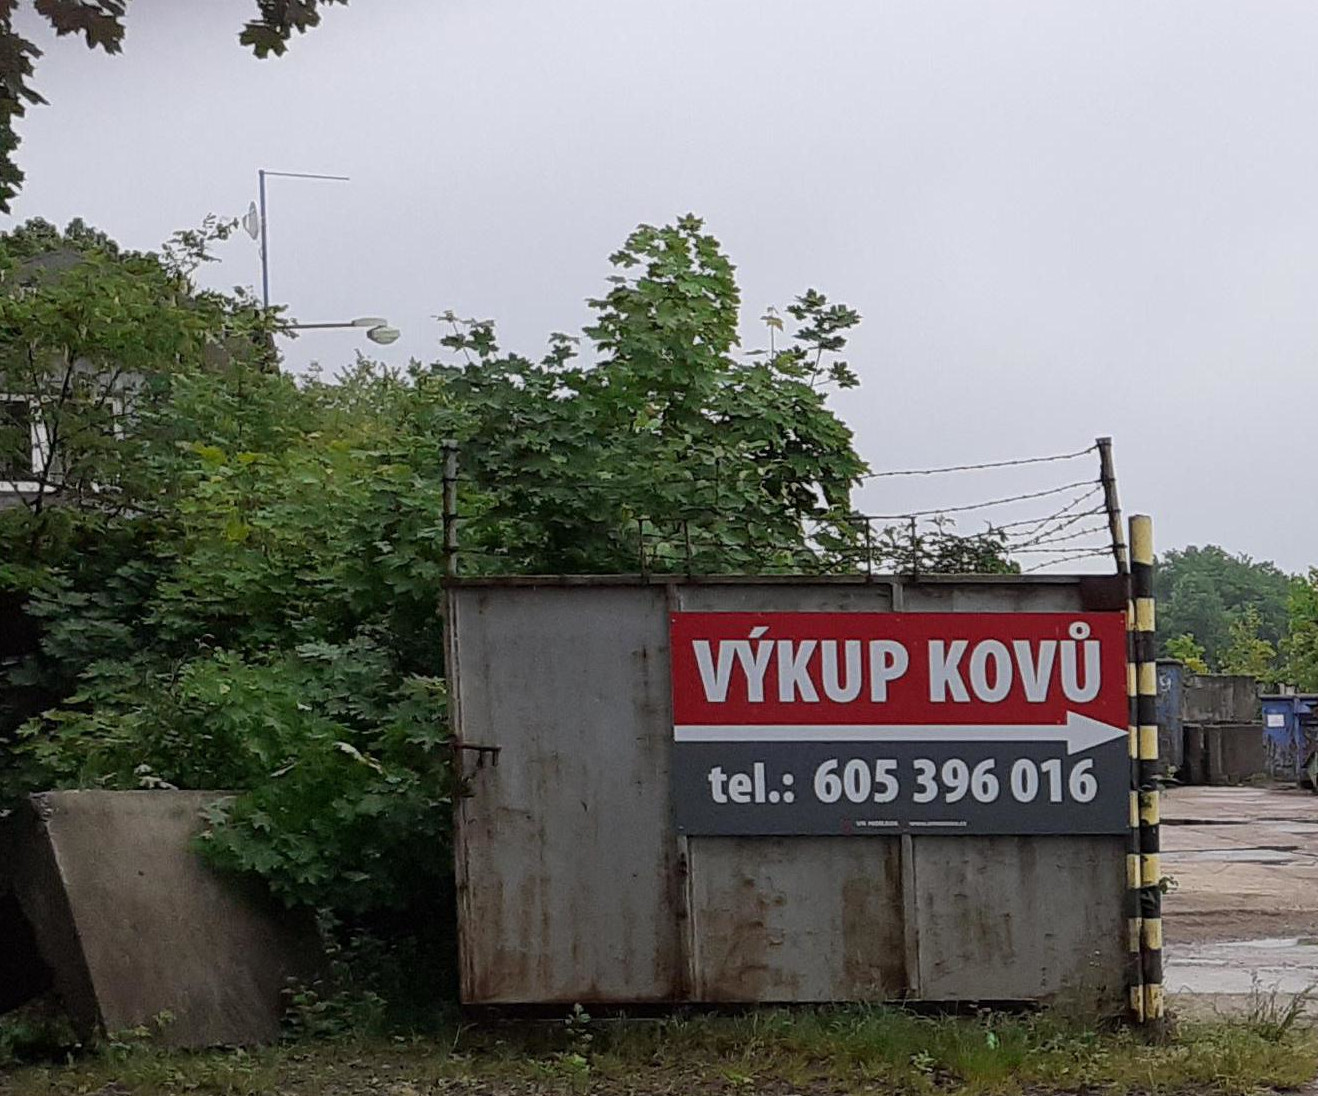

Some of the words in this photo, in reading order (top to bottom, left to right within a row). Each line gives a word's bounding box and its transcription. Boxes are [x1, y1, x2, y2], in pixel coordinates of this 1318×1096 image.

[692, 626, 909, 703] VÝKUP
[928, 621, 1101, 703] KOVŮ
[708, 762, 795, 803] tel.:
[814, 759, 899, 803] 605
[913, 758, 999, 803] 396
[1010, 758, 1098, 803] 016
